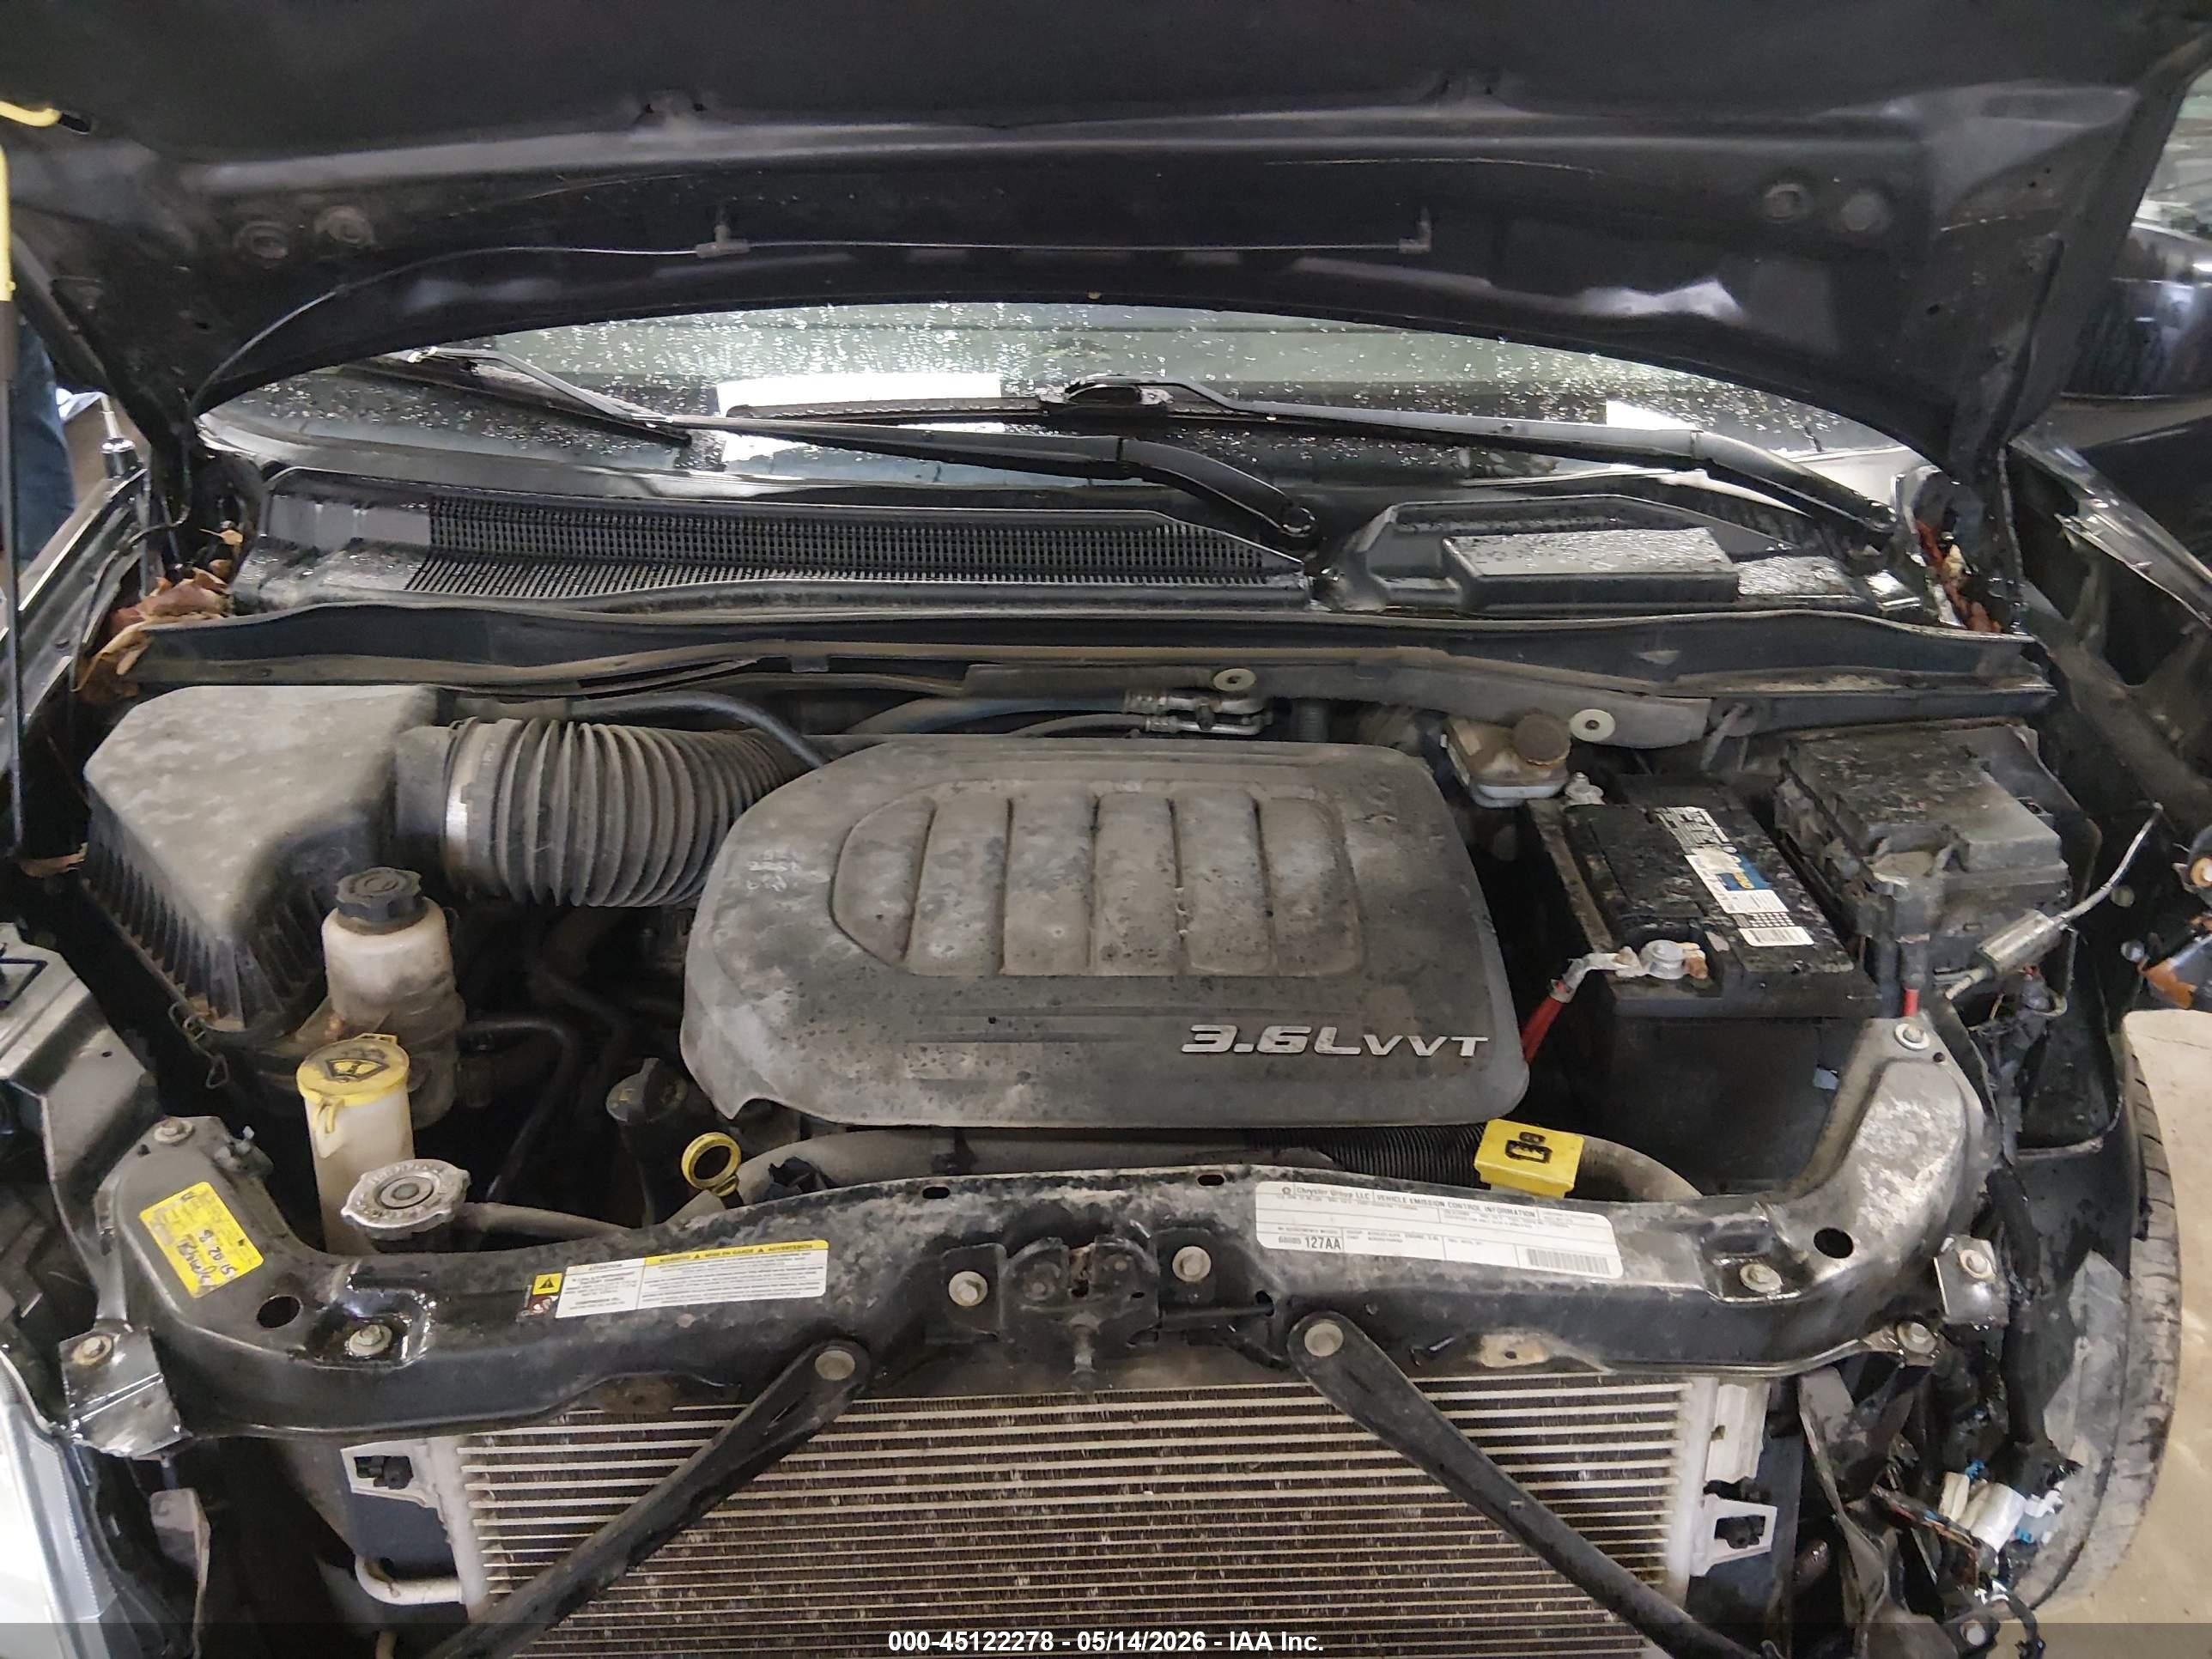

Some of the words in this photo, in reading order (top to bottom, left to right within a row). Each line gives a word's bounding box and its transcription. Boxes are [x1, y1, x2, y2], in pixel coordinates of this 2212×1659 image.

[1447, 1201, 1480, 1212] CONTROL
[1484, 1205, 1536, 1218] INFORMATION
[1305, 1236, 1341, 1250] 127AA
